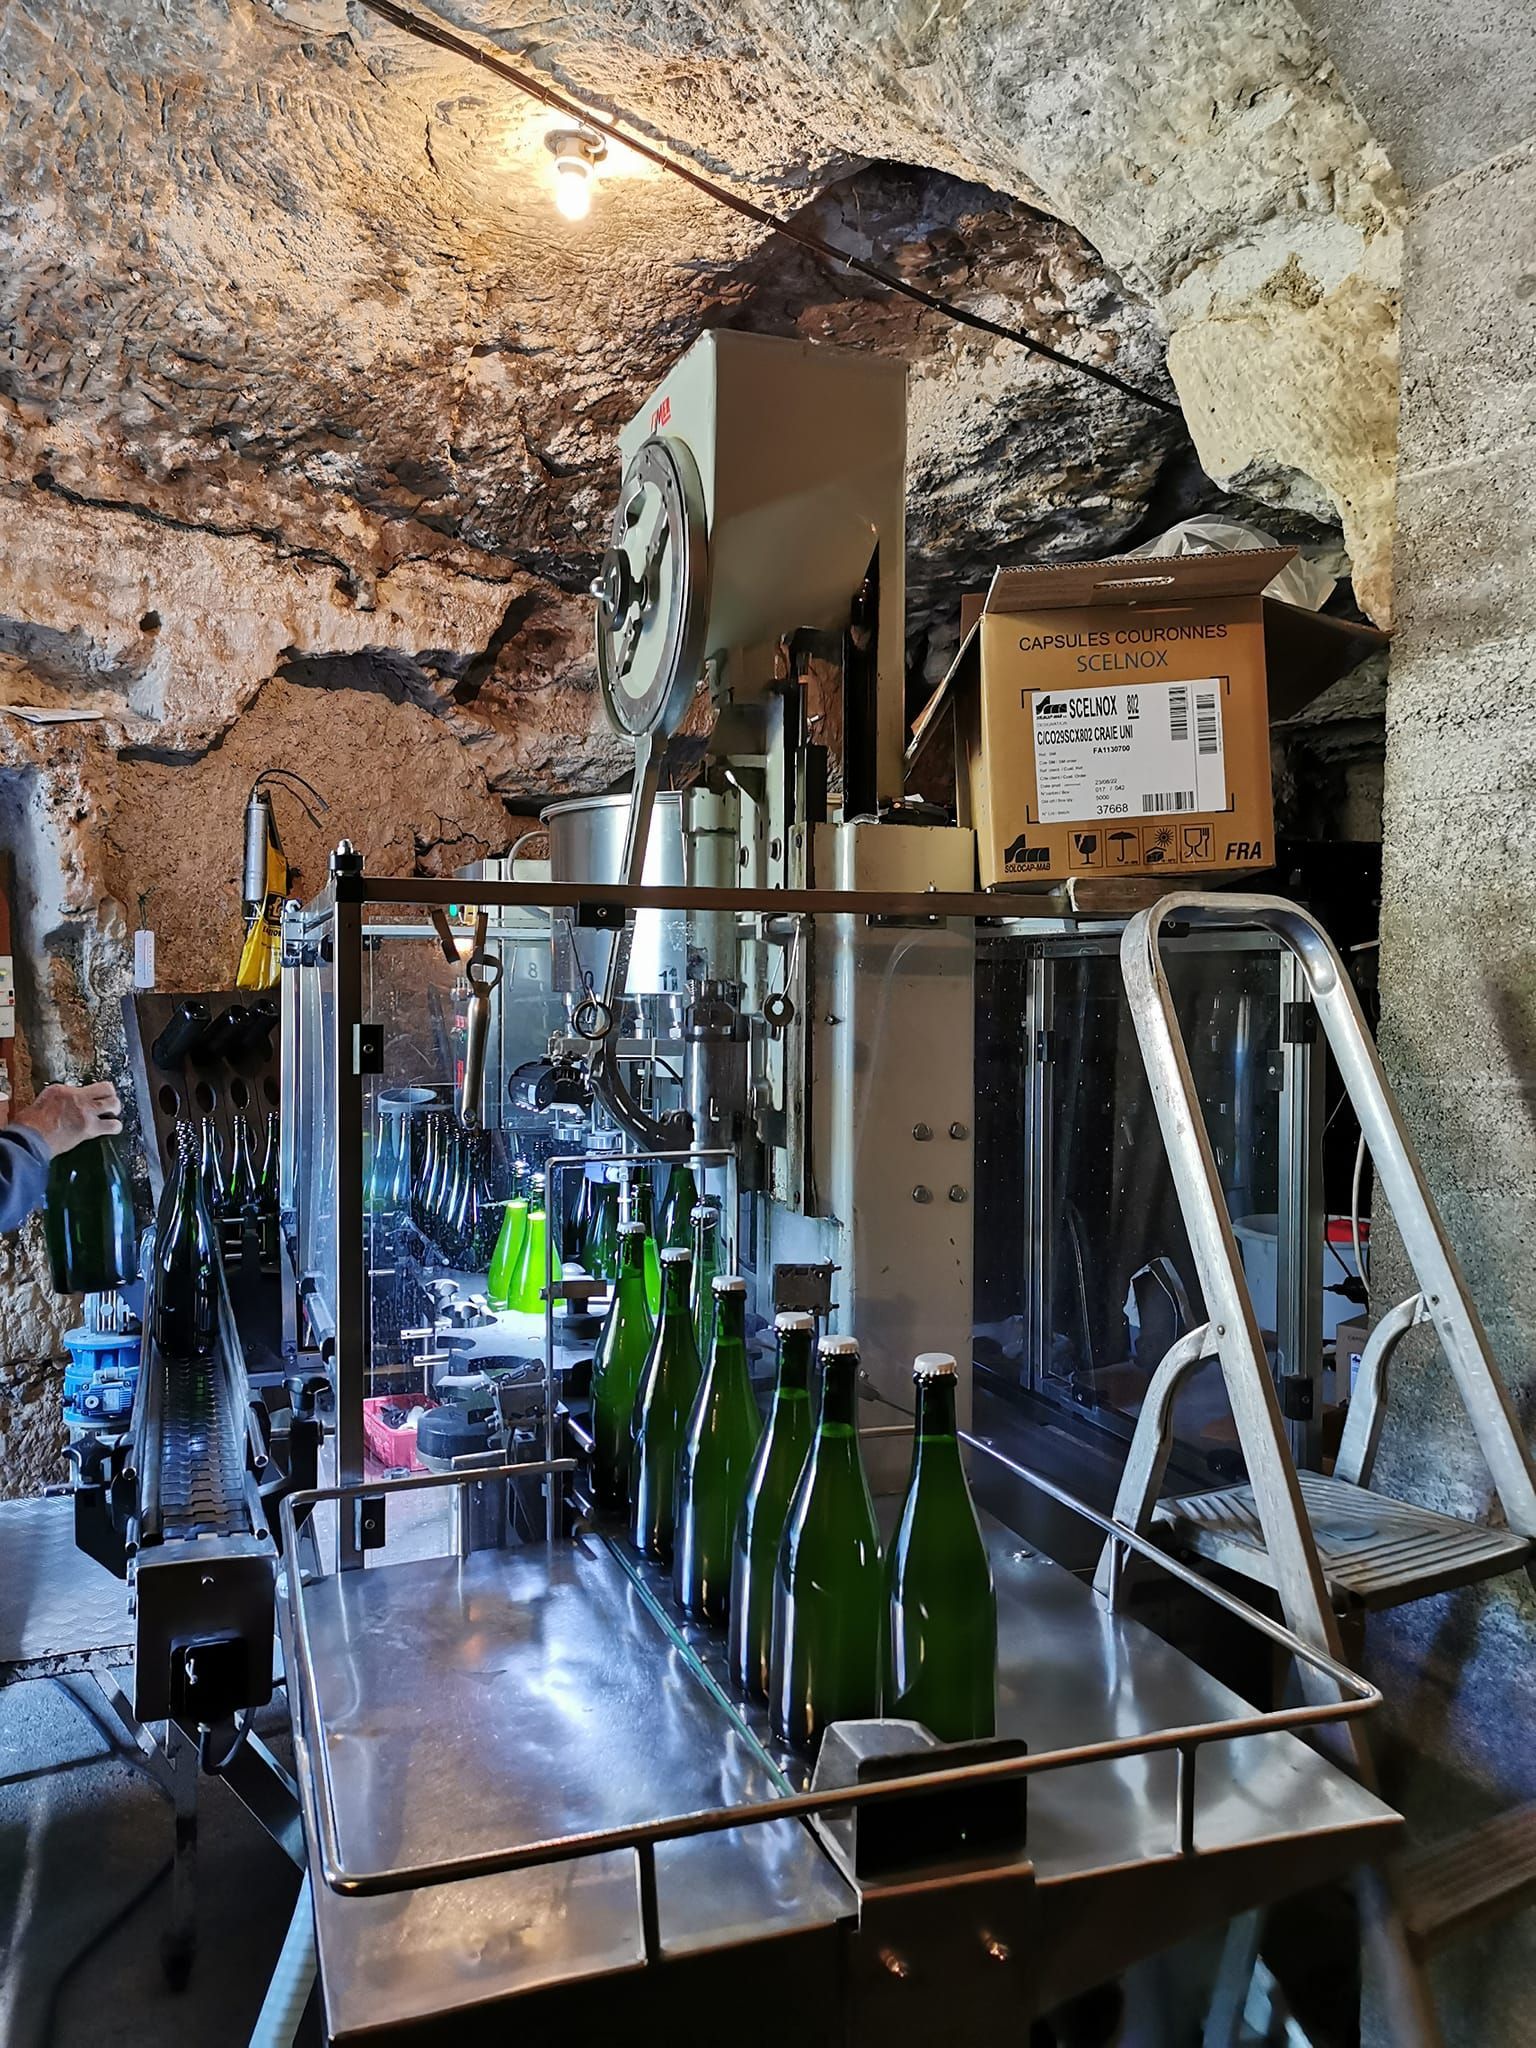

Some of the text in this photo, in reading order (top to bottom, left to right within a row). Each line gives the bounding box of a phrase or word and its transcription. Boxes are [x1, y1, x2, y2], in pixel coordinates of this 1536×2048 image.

[1019, 624, 1228, 651] CAPSULES COURONNES
[1076, 650, 1168, 672] SCELNOX
[1069, 694, 1139, 719] SCELNOX 802
[1094, 726, 1118, 741] CRAIE
[1119, 724, 1133, 739] UNI
[1096, 803, 1128, 815] 37668
[1225, 841, 1262, 861] FRA
[1004, 862, 1051, 874] SOLOCAP-MAB
[528, 962, 537, 978] 8
